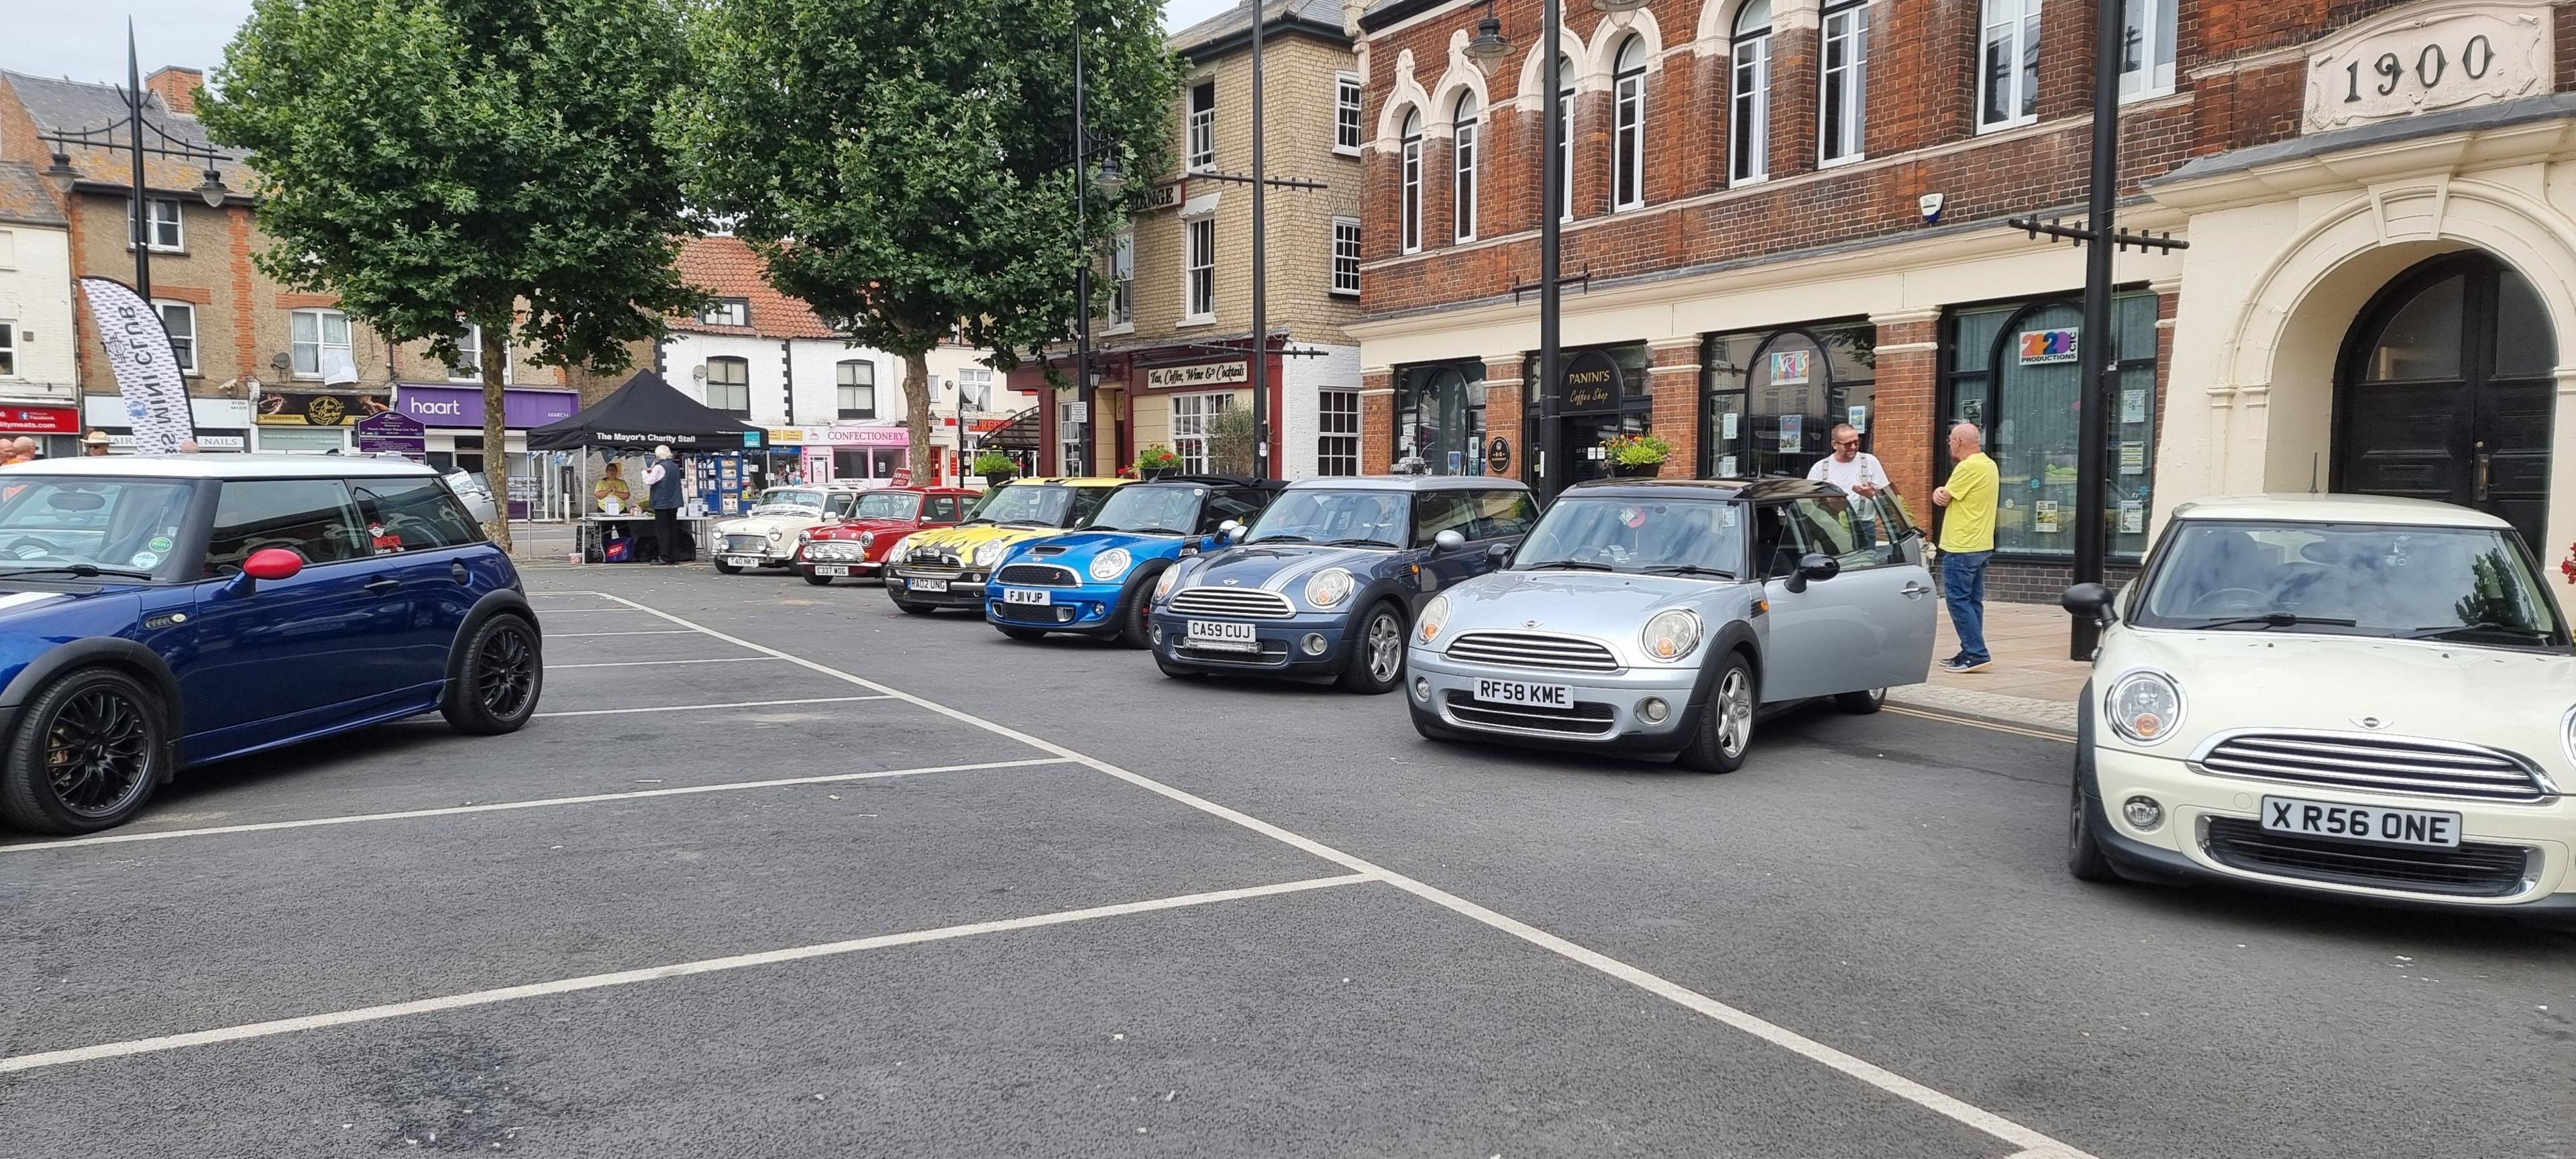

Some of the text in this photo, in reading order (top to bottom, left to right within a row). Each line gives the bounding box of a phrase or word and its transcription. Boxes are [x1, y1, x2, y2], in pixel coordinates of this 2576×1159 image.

[2344, 34, 2497, 103] 1900
[2021, 353, 2076, 363] PRODUCTIONS
[1150, 364, 1245, 385] Tea, Coffee, Wine & Cocktails
[1569, 370, 1610, 384] PANINI'S
[1570, 388, 1608, 406] Coffee Shop
[411, 396, 460, 415] haart
[614, 433, 646, 442] Mayor's
[648, 434, 676, 443] Charity
[828, 431, 904, 441] CONFECTIONERY
[912, 579, 945, 590] RA02 UNG
[1010, 591, 1042, 603] FJ11 VJP
[1193, 622, 1250, 638] CA59 CUJ
[1481, 680, 1566, 704] RF58 KME
[2272, 802, 2451, 844] X R56 ONE
